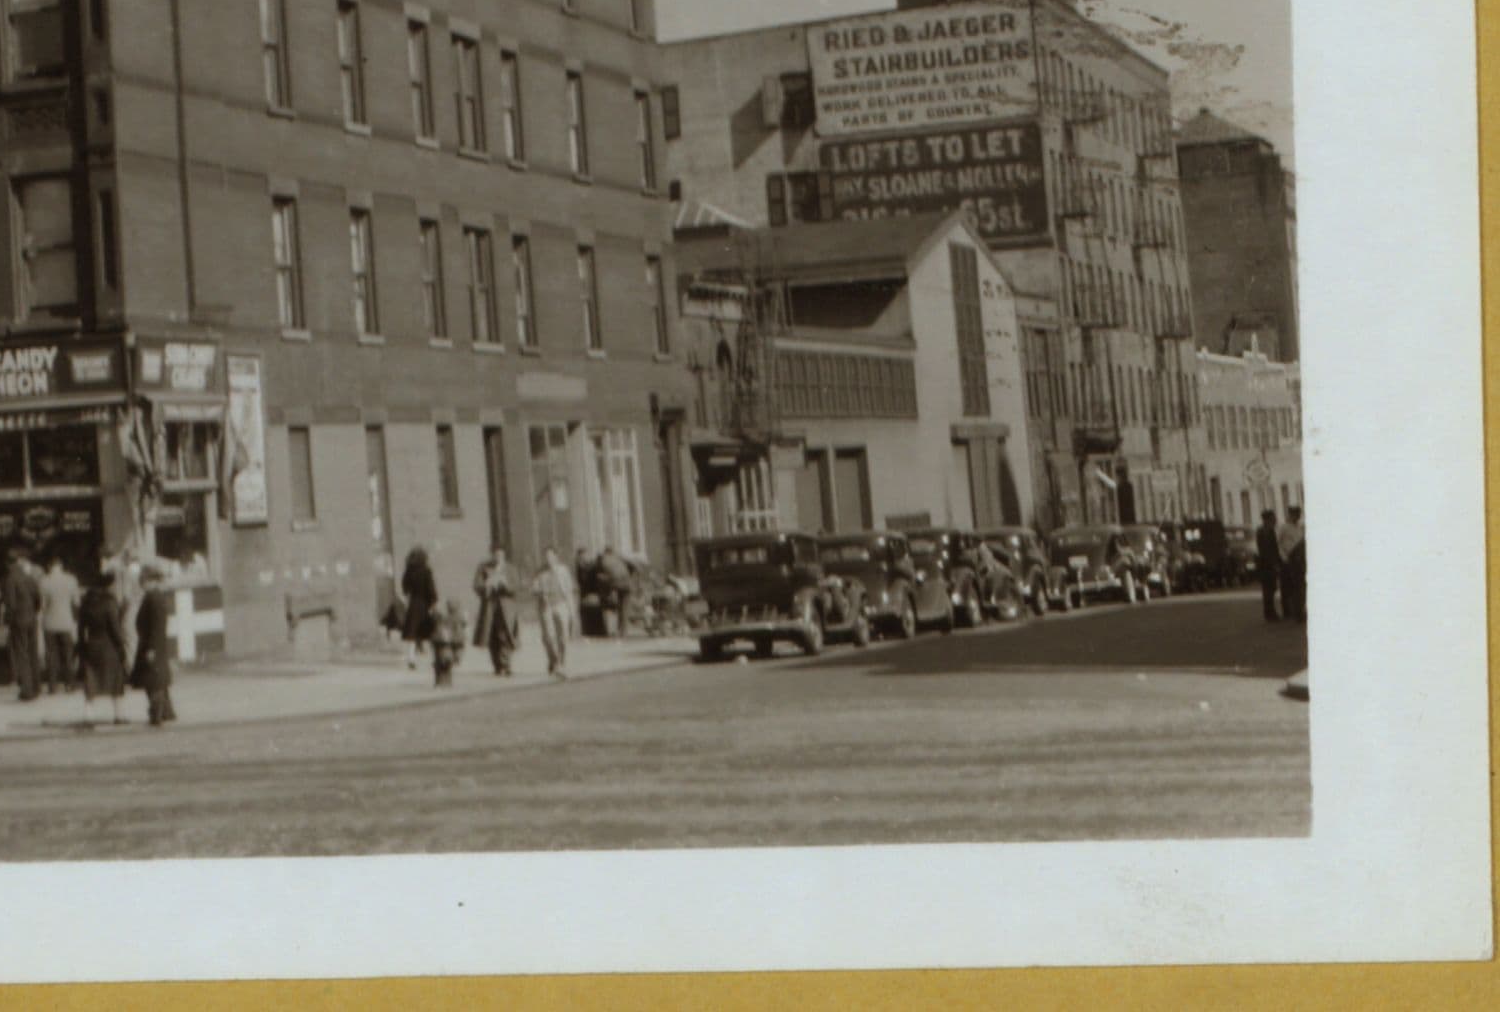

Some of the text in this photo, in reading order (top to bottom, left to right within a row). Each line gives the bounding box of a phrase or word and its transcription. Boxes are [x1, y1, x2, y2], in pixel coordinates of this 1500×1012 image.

[824, 13, 1015, 52] RIED & JAEGER
[834, 40, 1029, 79] STAIRBUILDERS
[822, 96, 861, 113] WORK
[867, 88, 946, 109] DELIVERED
[976, 84, 1005, 99] ALL
[842, 101, 993, 127] PARTS OF COUNTRY
[831, 128, 1025, 172] LOFTS TO LET
[868, 170, 944, 201] SLOANE
